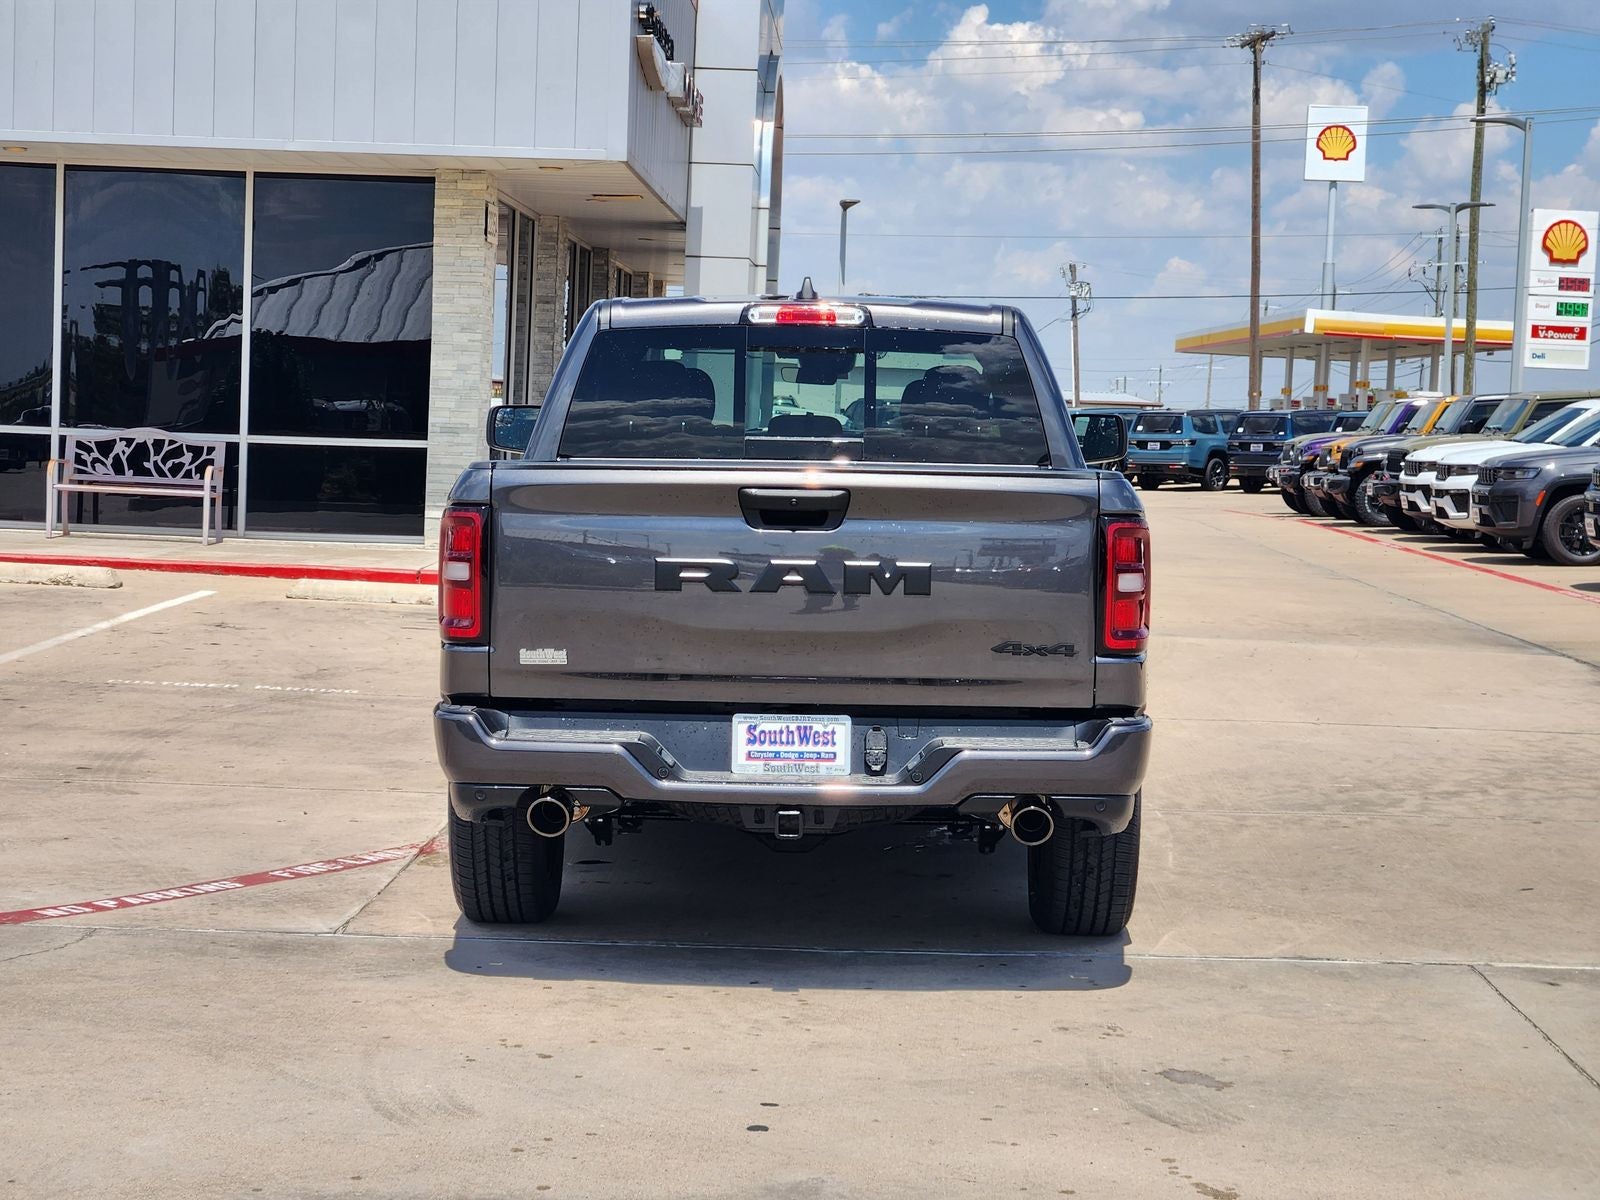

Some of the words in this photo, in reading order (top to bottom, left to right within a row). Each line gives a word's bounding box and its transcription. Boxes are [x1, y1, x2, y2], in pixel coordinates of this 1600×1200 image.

[1538, 330, 1577, 340] V-Power
[655, 557, 932, 596] RAM
[746, 724, 837, 747] SouthWest
[750, 751, 775, 760] Chrysler
[780, 752, 799, 760] Dodge
[803, 752, 817, 760] Jeep
[820, 752, 835, 760] Ram
[763, 762, 821, 774] SouthWest
[34, 905, 92, 917] NO
[93, 880, 245, 908] PARKING
